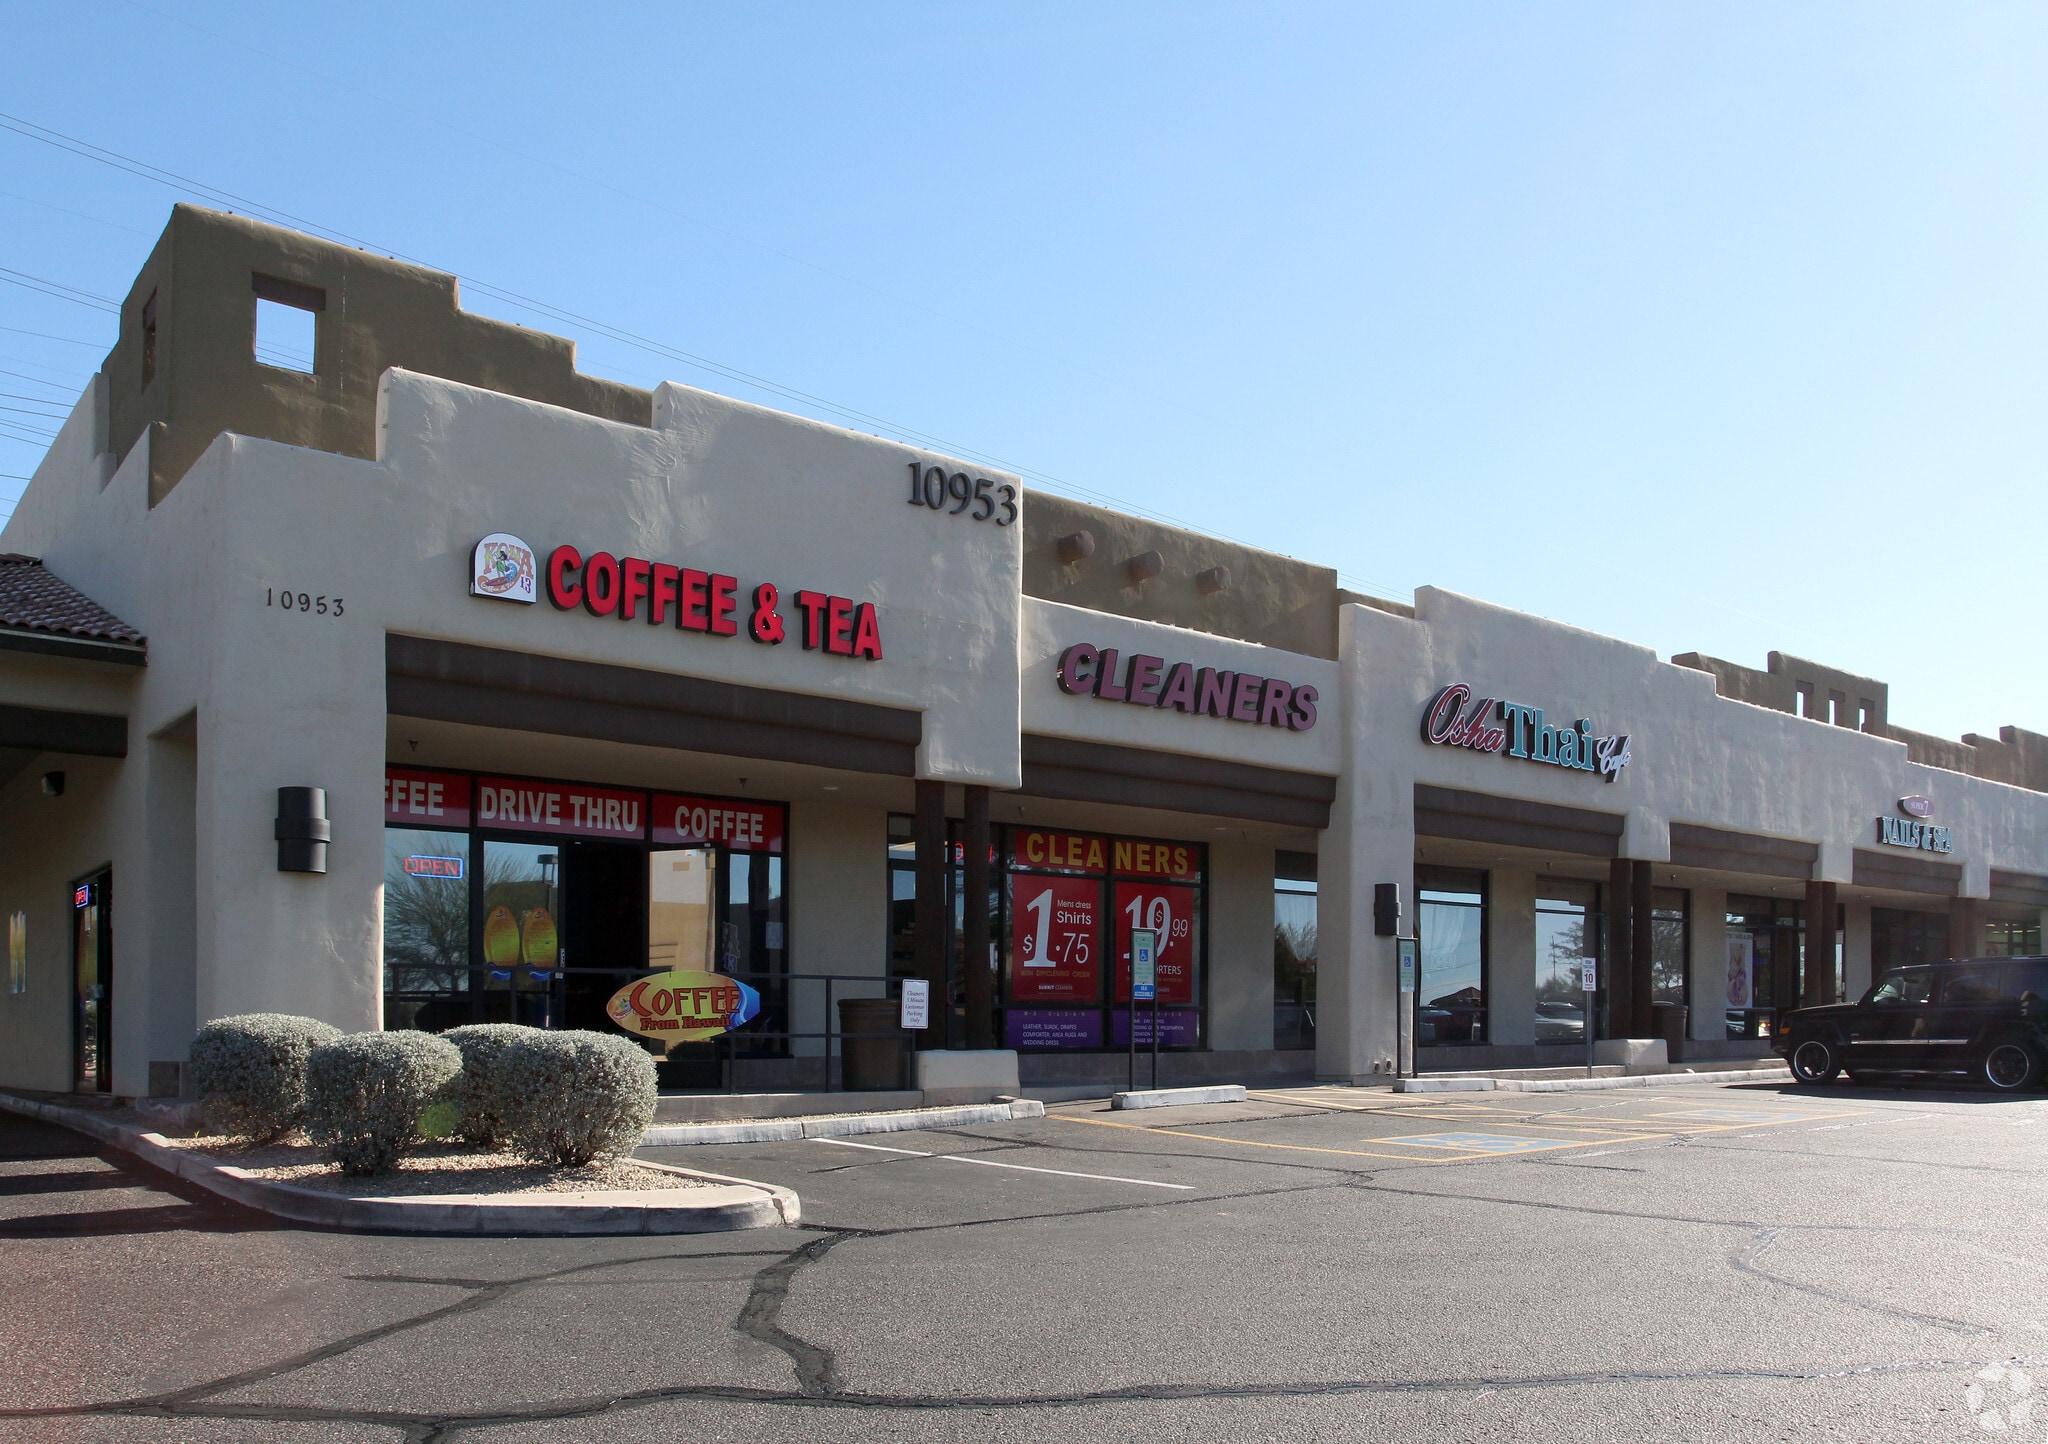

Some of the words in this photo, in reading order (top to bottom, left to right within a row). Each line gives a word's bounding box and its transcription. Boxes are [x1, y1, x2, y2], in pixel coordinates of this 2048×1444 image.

[907, 461, 1018, 526] 10953
[267, 587, 344, 617] 10953
[521, 576, 532, 594] 13
[547, 545, 737, 637] COFFEE
[749, 582, 785, 645] &
[794, 590, 883, 661] TEA
[1057, 642, 1319, 731] CLEANERS
[1421, 683, 1505, 753] Osha
[1497, 700, 1595, 772] Thai
[480, 787, 561, 825] DRIVE
[569, 795, 639, 832] THRU
[674, 805, 764, 843] COFFEE
[1876, 816, 1920, 848] NAILS
[1931, 826, 1954, 853] SPA
[404, 858, 460, 875] OPEN
[1057, 899, 1074, 908] Mens
[1075, 901, 1091, 909] dress
[1057, 911, 1091, 925] Shirts
[1584, 973, 1594, 983] 10
[630, 982, 740, 1017] COFFEE
[640, 1017, 679, 1031] From
[682, 1015, 731, 1029] Hawaii
